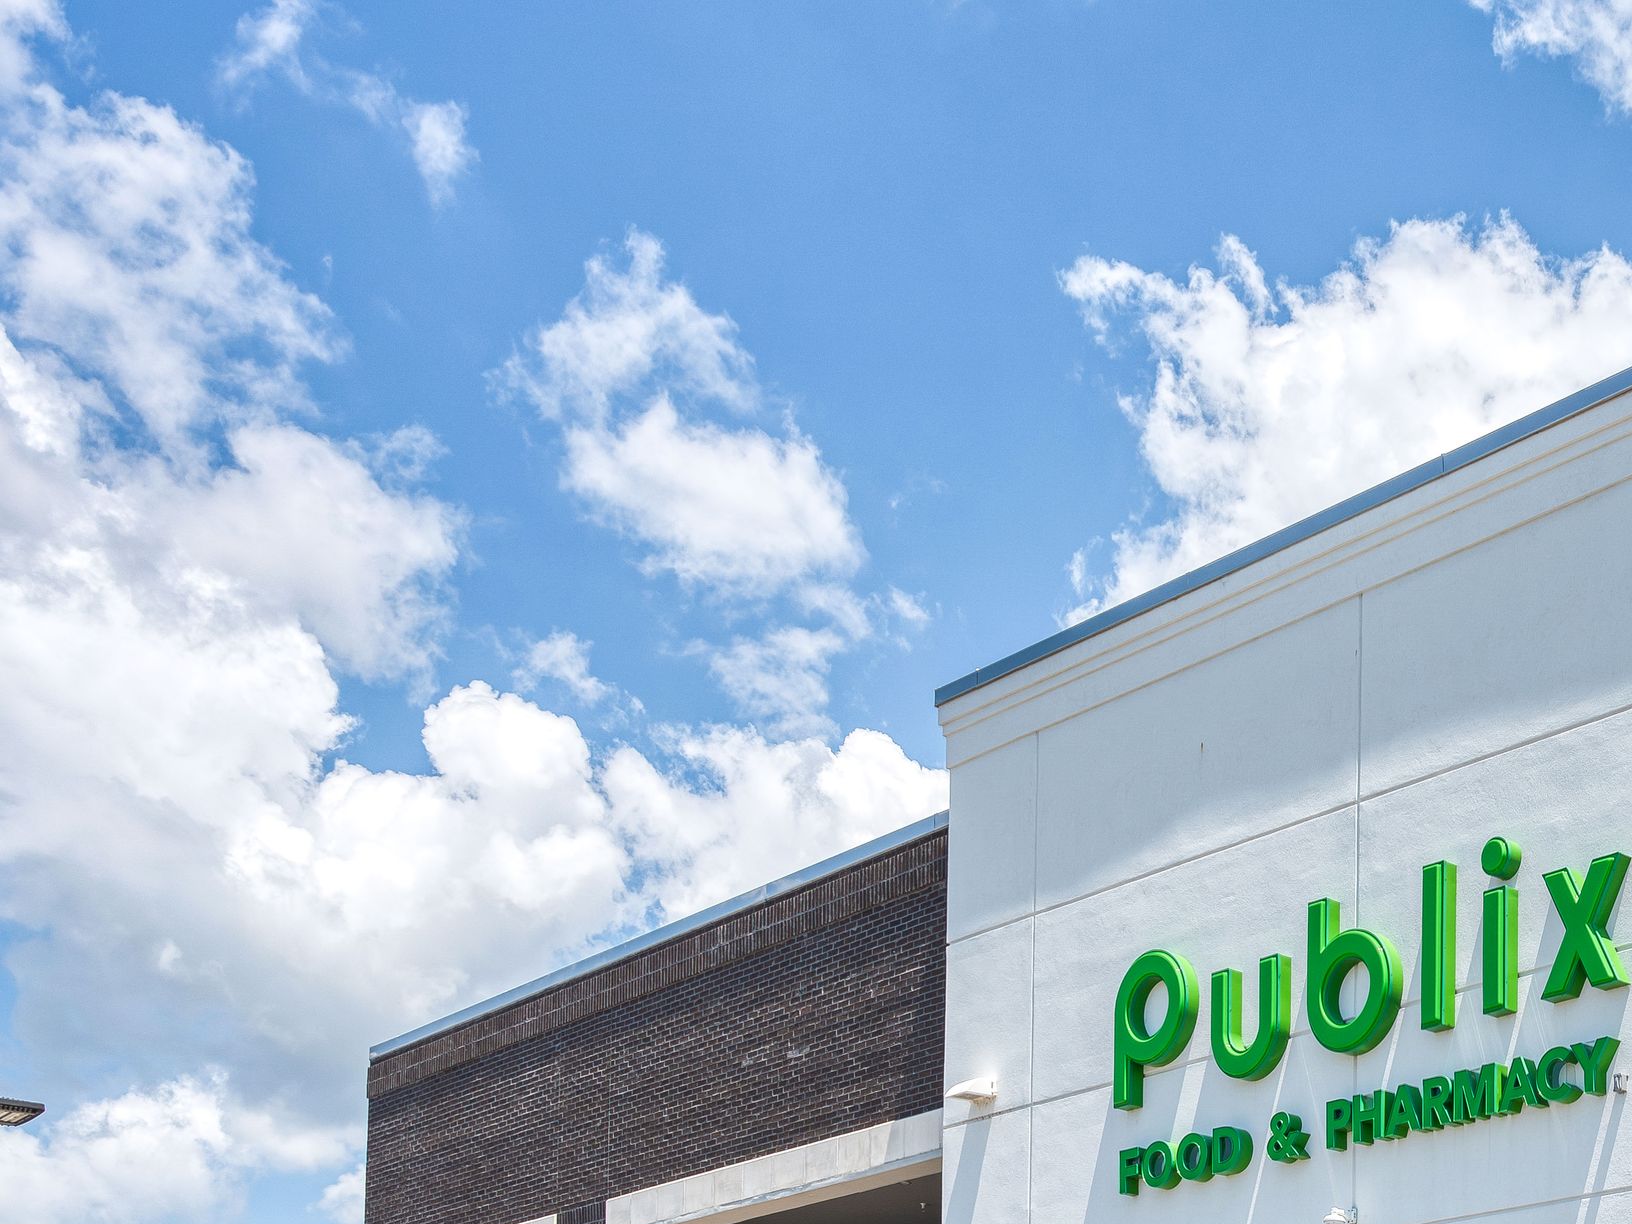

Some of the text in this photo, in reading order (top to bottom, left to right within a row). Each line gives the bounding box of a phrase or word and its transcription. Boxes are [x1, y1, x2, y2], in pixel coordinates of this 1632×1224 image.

[1119, 1035, 1621, 1196] FOOD & PHARMACY
